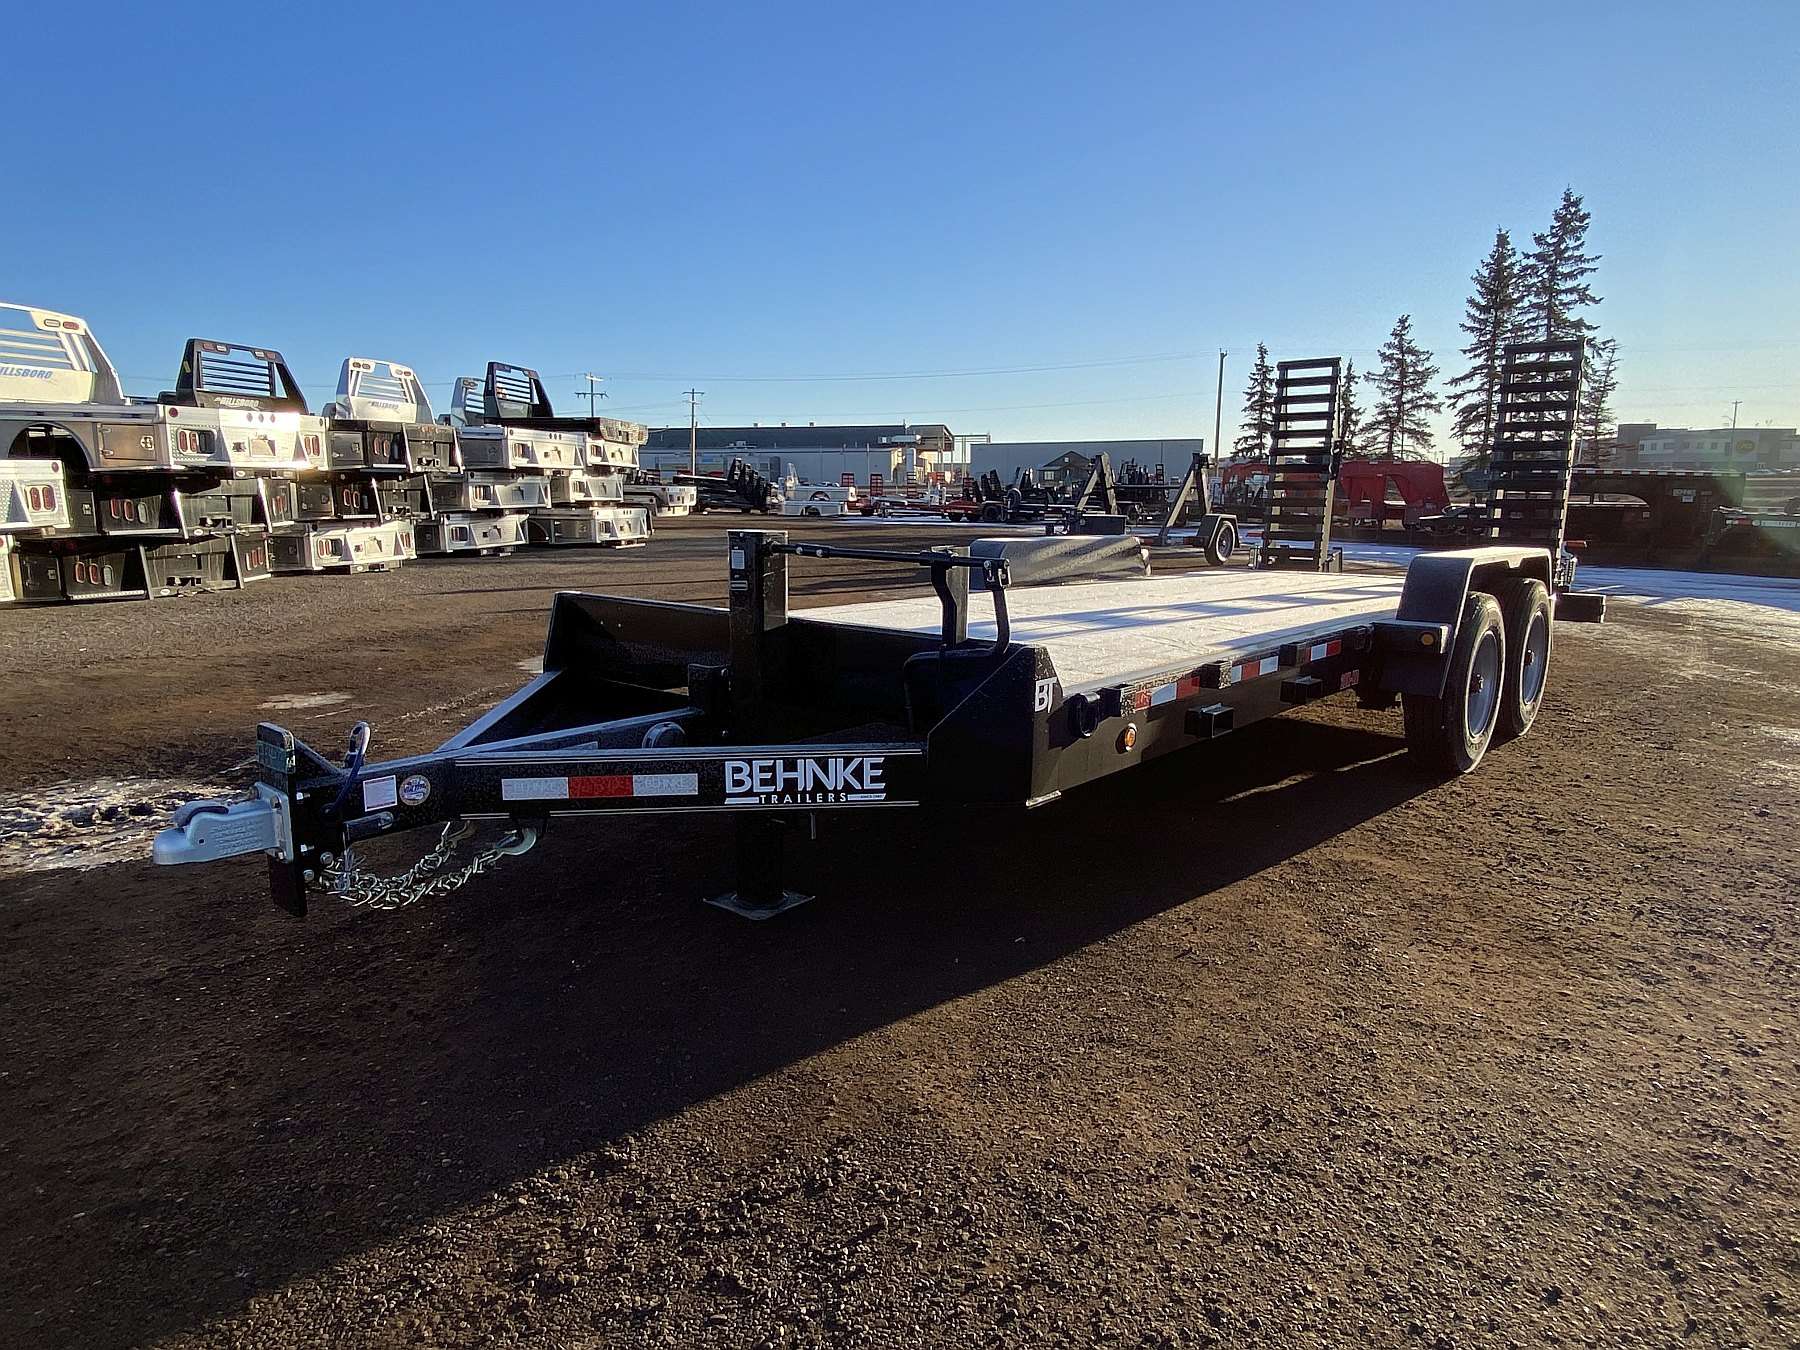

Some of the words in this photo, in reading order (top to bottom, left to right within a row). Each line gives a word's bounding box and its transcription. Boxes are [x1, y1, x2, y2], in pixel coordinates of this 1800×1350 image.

[0, 366, 53, 379] ILLSBORO
[1034, 676, 1058, 714] BT
[724, 757, 886, 793] BEHNKE
[759, 793, 847, 804] TRAILERS
